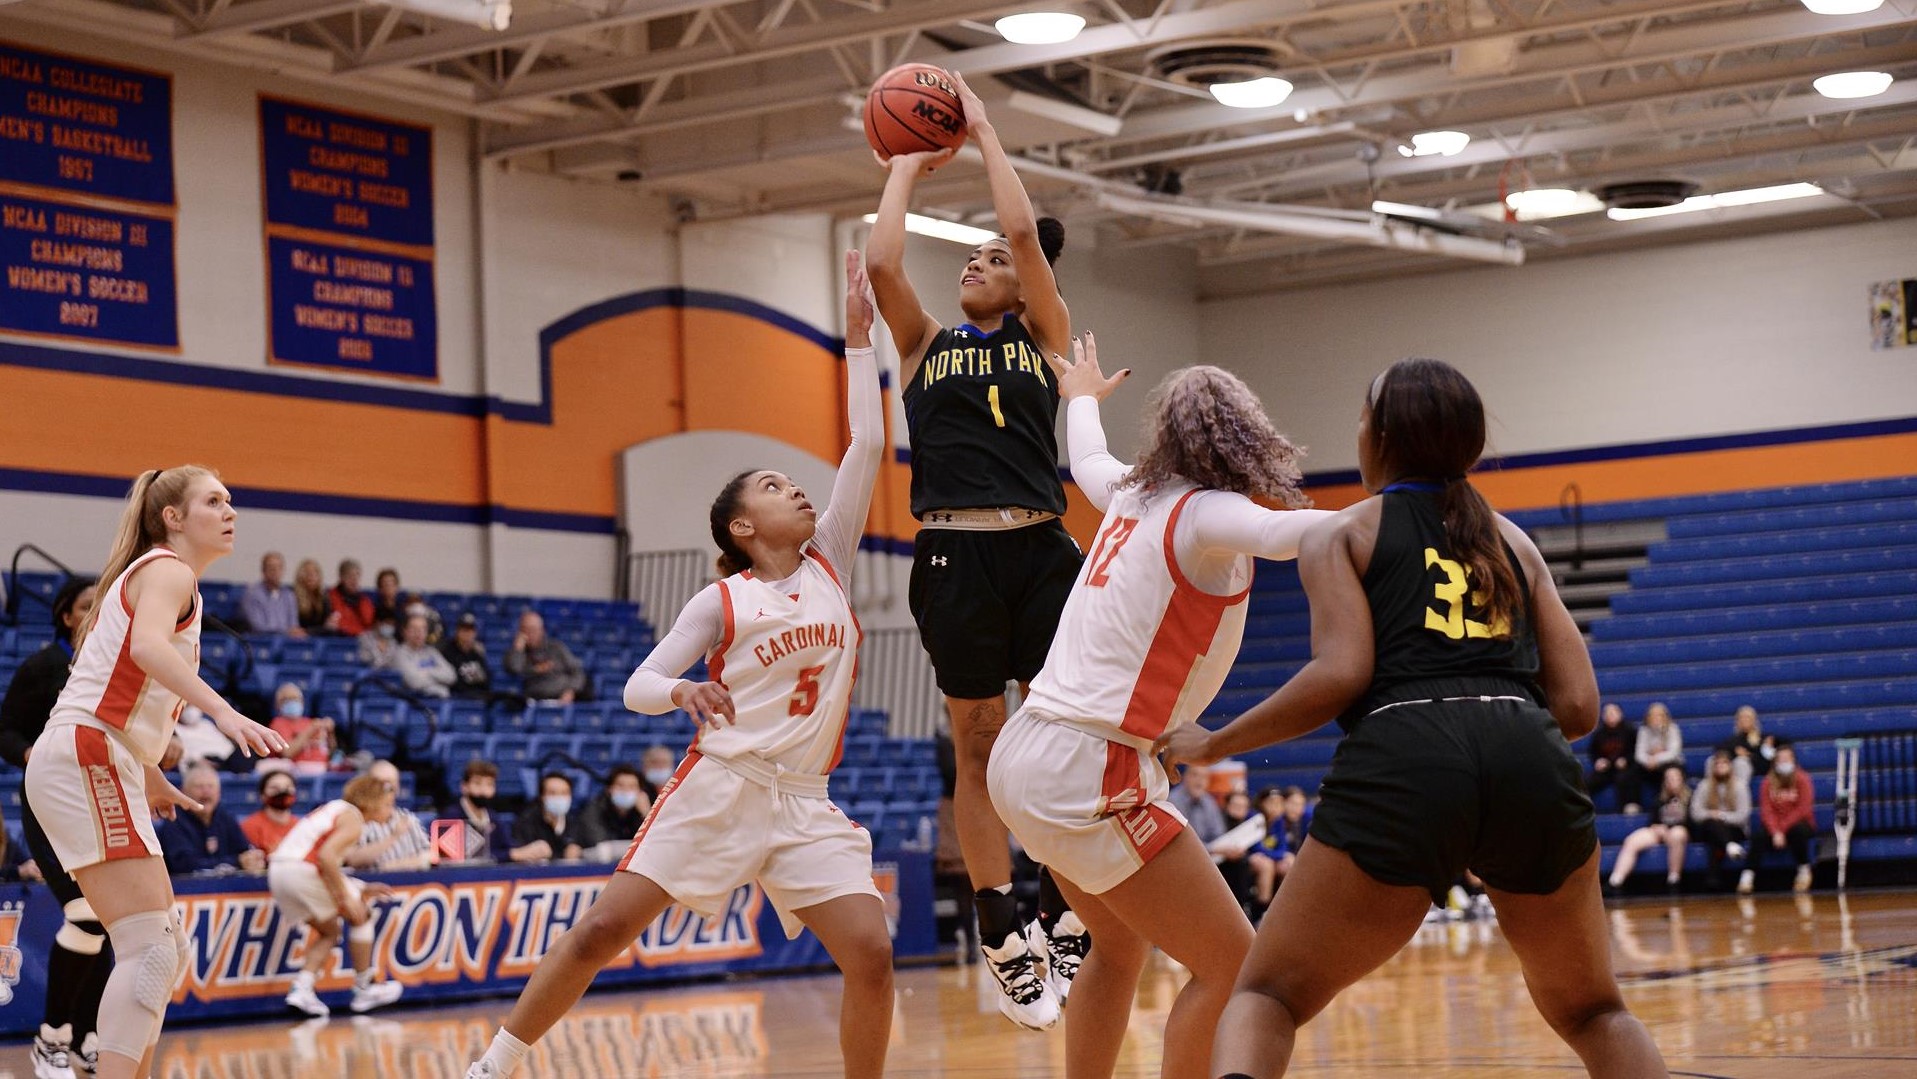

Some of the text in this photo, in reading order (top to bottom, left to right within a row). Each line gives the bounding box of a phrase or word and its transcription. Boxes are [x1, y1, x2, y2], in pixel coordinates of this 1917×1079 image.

[0, 55, 144, 104] NCAA COLLEGIATE
[27, 89, 118, 128] CHAMPIONS
[911, 100, 961, 136] NCAA
[52, 124, 152, 164] BASKETBALL
[3, 204, 47, 232] NCAA
[55, 211, 122, 243] DIVISION
[31, 239, 123, 272] CHAMPIONS
[8, 265, 148, 304] WOMEN'S SOCCER
[293, 303, 358, 333] WOMEN'S
[924, 340, 1048, 390] NORTH PAK
[988, 385, 1005, 427] 1
[1085, 516, 1139, 588] 12
[789, 665, 826, 717] 5
[174, 878, 757, 990] WHETON THDER
